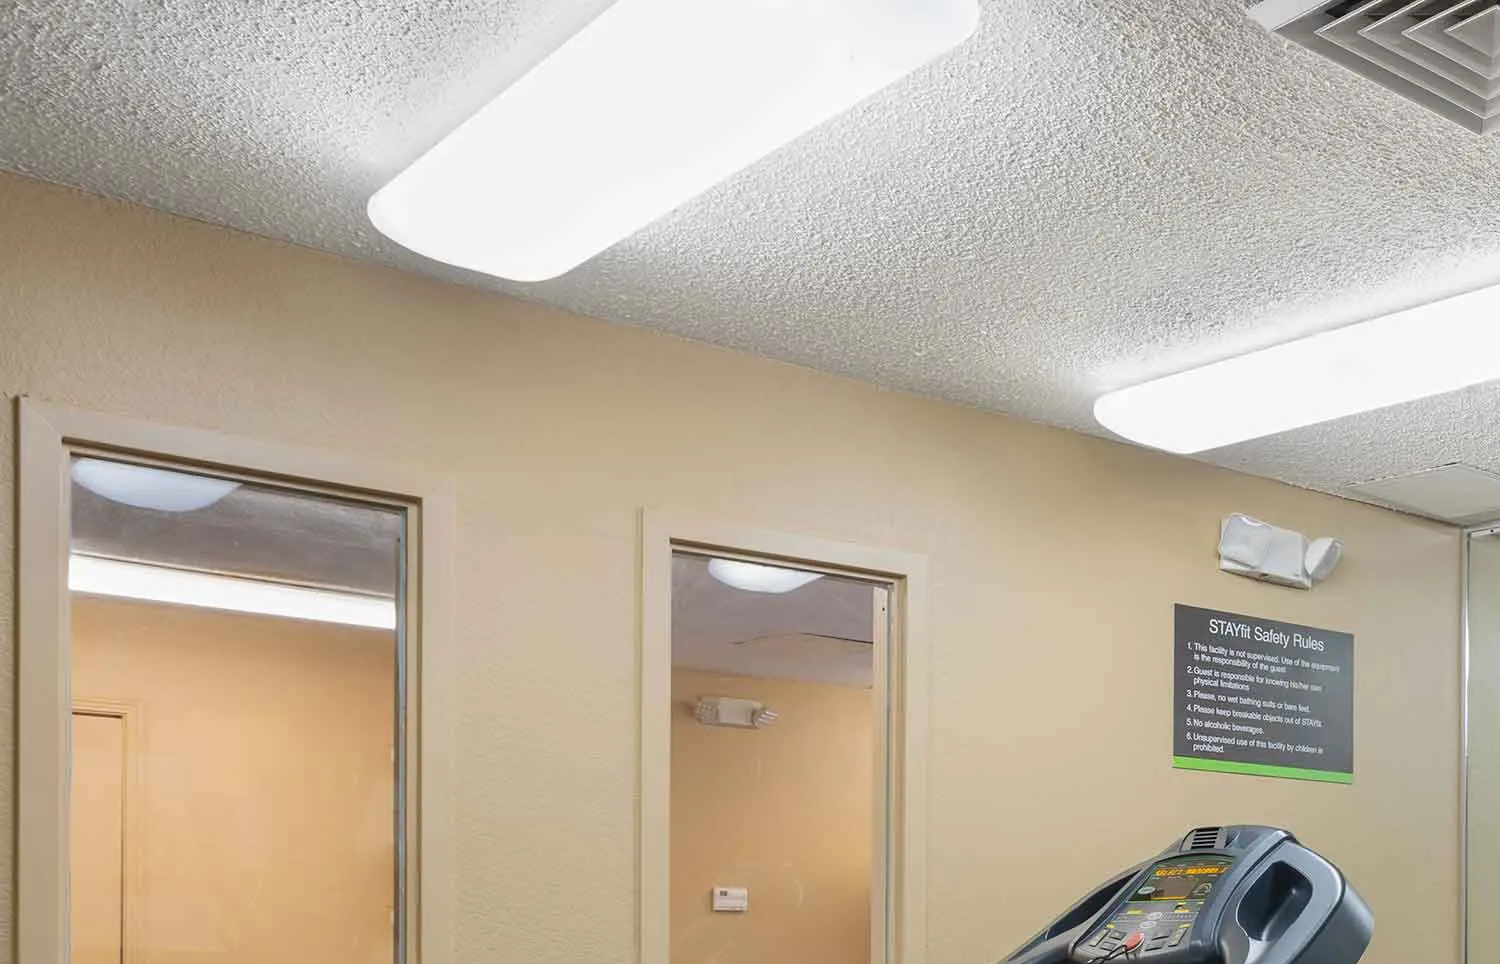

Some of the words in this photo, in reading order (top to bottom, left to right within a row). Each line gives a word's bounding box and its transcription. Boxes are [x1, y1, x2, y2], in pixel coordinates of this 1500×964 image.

[1209, 619, 1251, 639] STAYfit
[1254, 626, 1290, 649] Safety
[1293, 633, 1325, 652] Rules
[1193, 642, 1208, 652] This
[1208, 645, 1228, 657] facility
[1229, 648, 1235, 656] is
[1236, 650, 1246, 658] not
[1281, 657, 1293, 665] Use
[1294, 658, 1300, 666] of
[1193, 652, 1200, 661] is
[1201, 653, 1211, 662] the
[1212, 656, 1250, 669] responsibility
[1259, 662, 1268, 671] the
[1194, 666, 1212, 677] Guest
[1214, 670, 1220, 678] is
[1221, 672, 1255, 682] responsible
[1265, 678, 1289, 689] knowing
[1194, 676, 1219, 688] physical
[1228, 696, 1238, 704] wet
[1239, 696, 1261, 708] bathing
[1194, 704, 1215, 714] Please
[1216, 708, 1232, 717] keep
[1232, 710, 1262, 720] breakable
[1263, 714, 1283, 724] objects
[1194, 718, 1203, 727] No
[1204, 720, 1232, 730] alcoholic
[1193, 744, 1224, 753] prohibited.
[1194, 732, 1236, 745] Unsupervised
[1236, 738, 1248, 746] use
[1268, 740, 1286, 752] facility
[1286, 744, 1294, 753] by
[1295, 744, 1317, 754] children
